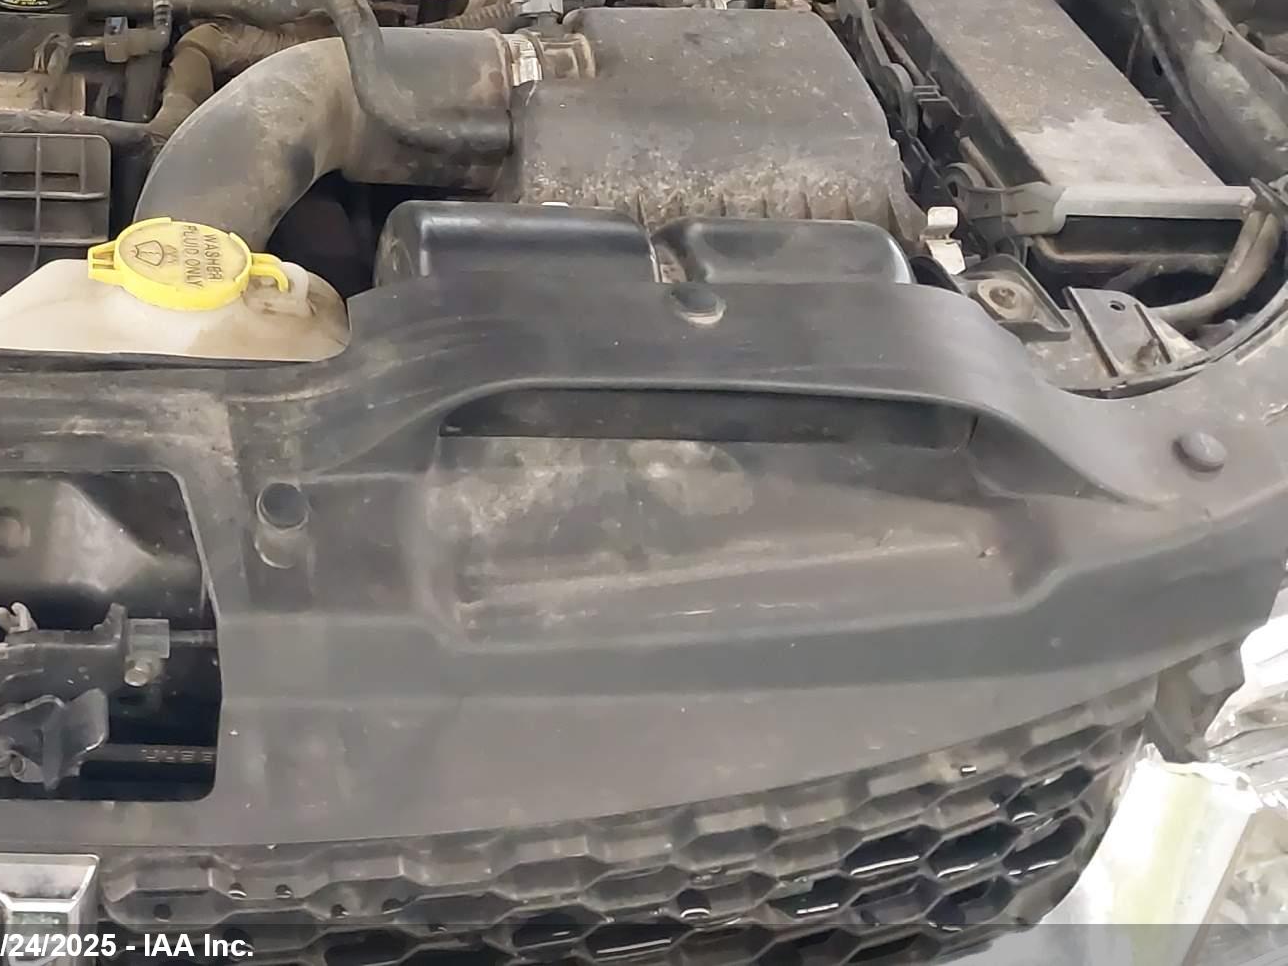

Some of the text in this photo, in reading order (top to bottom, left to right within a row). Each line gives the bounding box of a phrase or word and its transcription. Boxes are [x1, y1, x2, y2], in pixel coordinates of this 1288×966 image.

[183, 225, 203, 287] FLUID ONLY
[203, 234, 223, 280] WASHER
